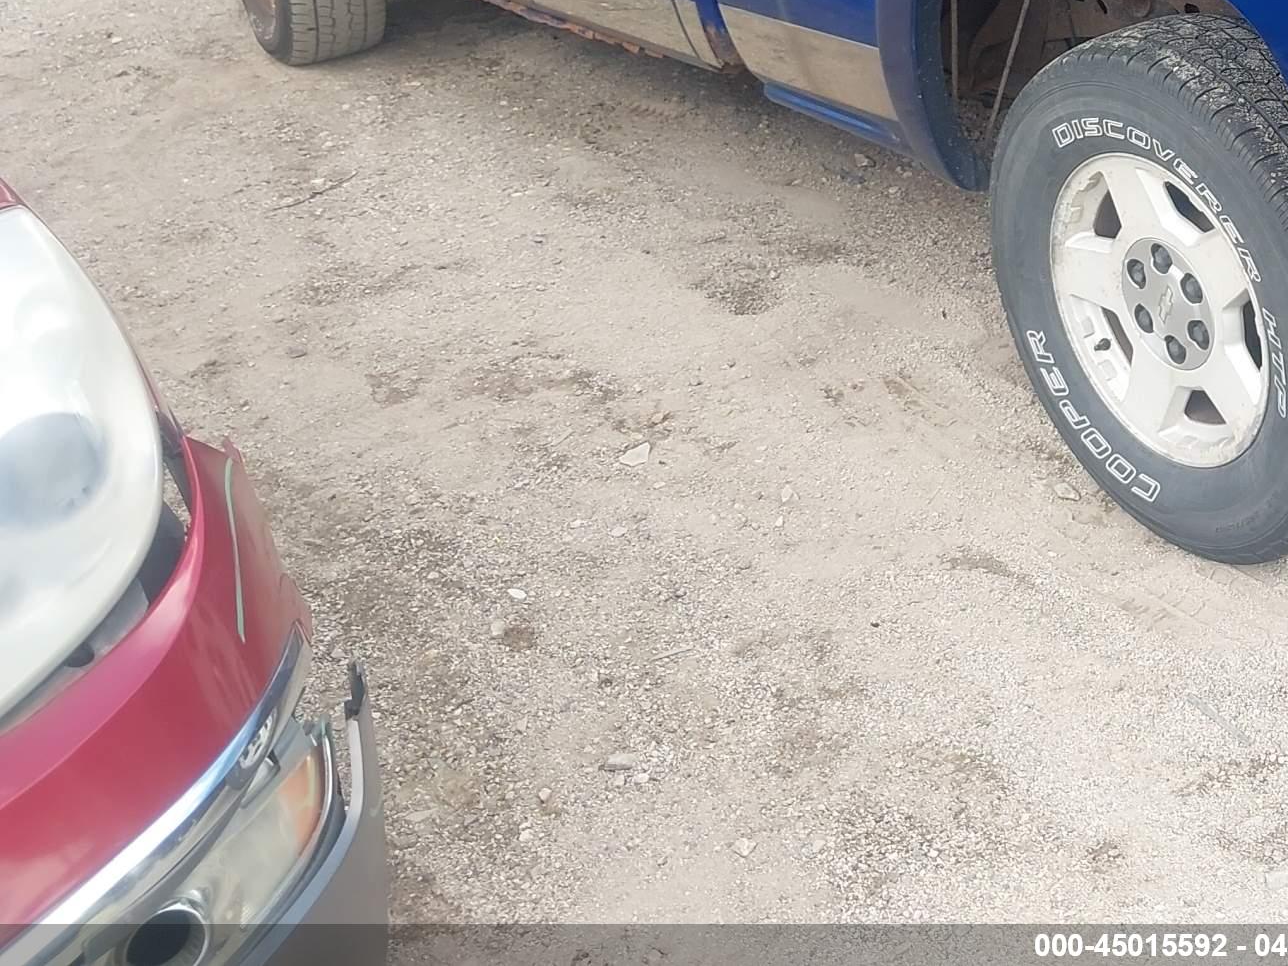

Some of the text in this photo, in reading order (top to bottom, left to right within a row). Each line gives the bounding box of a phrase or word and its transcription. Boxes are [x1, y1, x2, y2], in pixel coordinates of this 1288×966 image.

[1052, 117, 1288, 419] DISCOVERER HTP
[1026, 330, 1161, 502] COOPER
